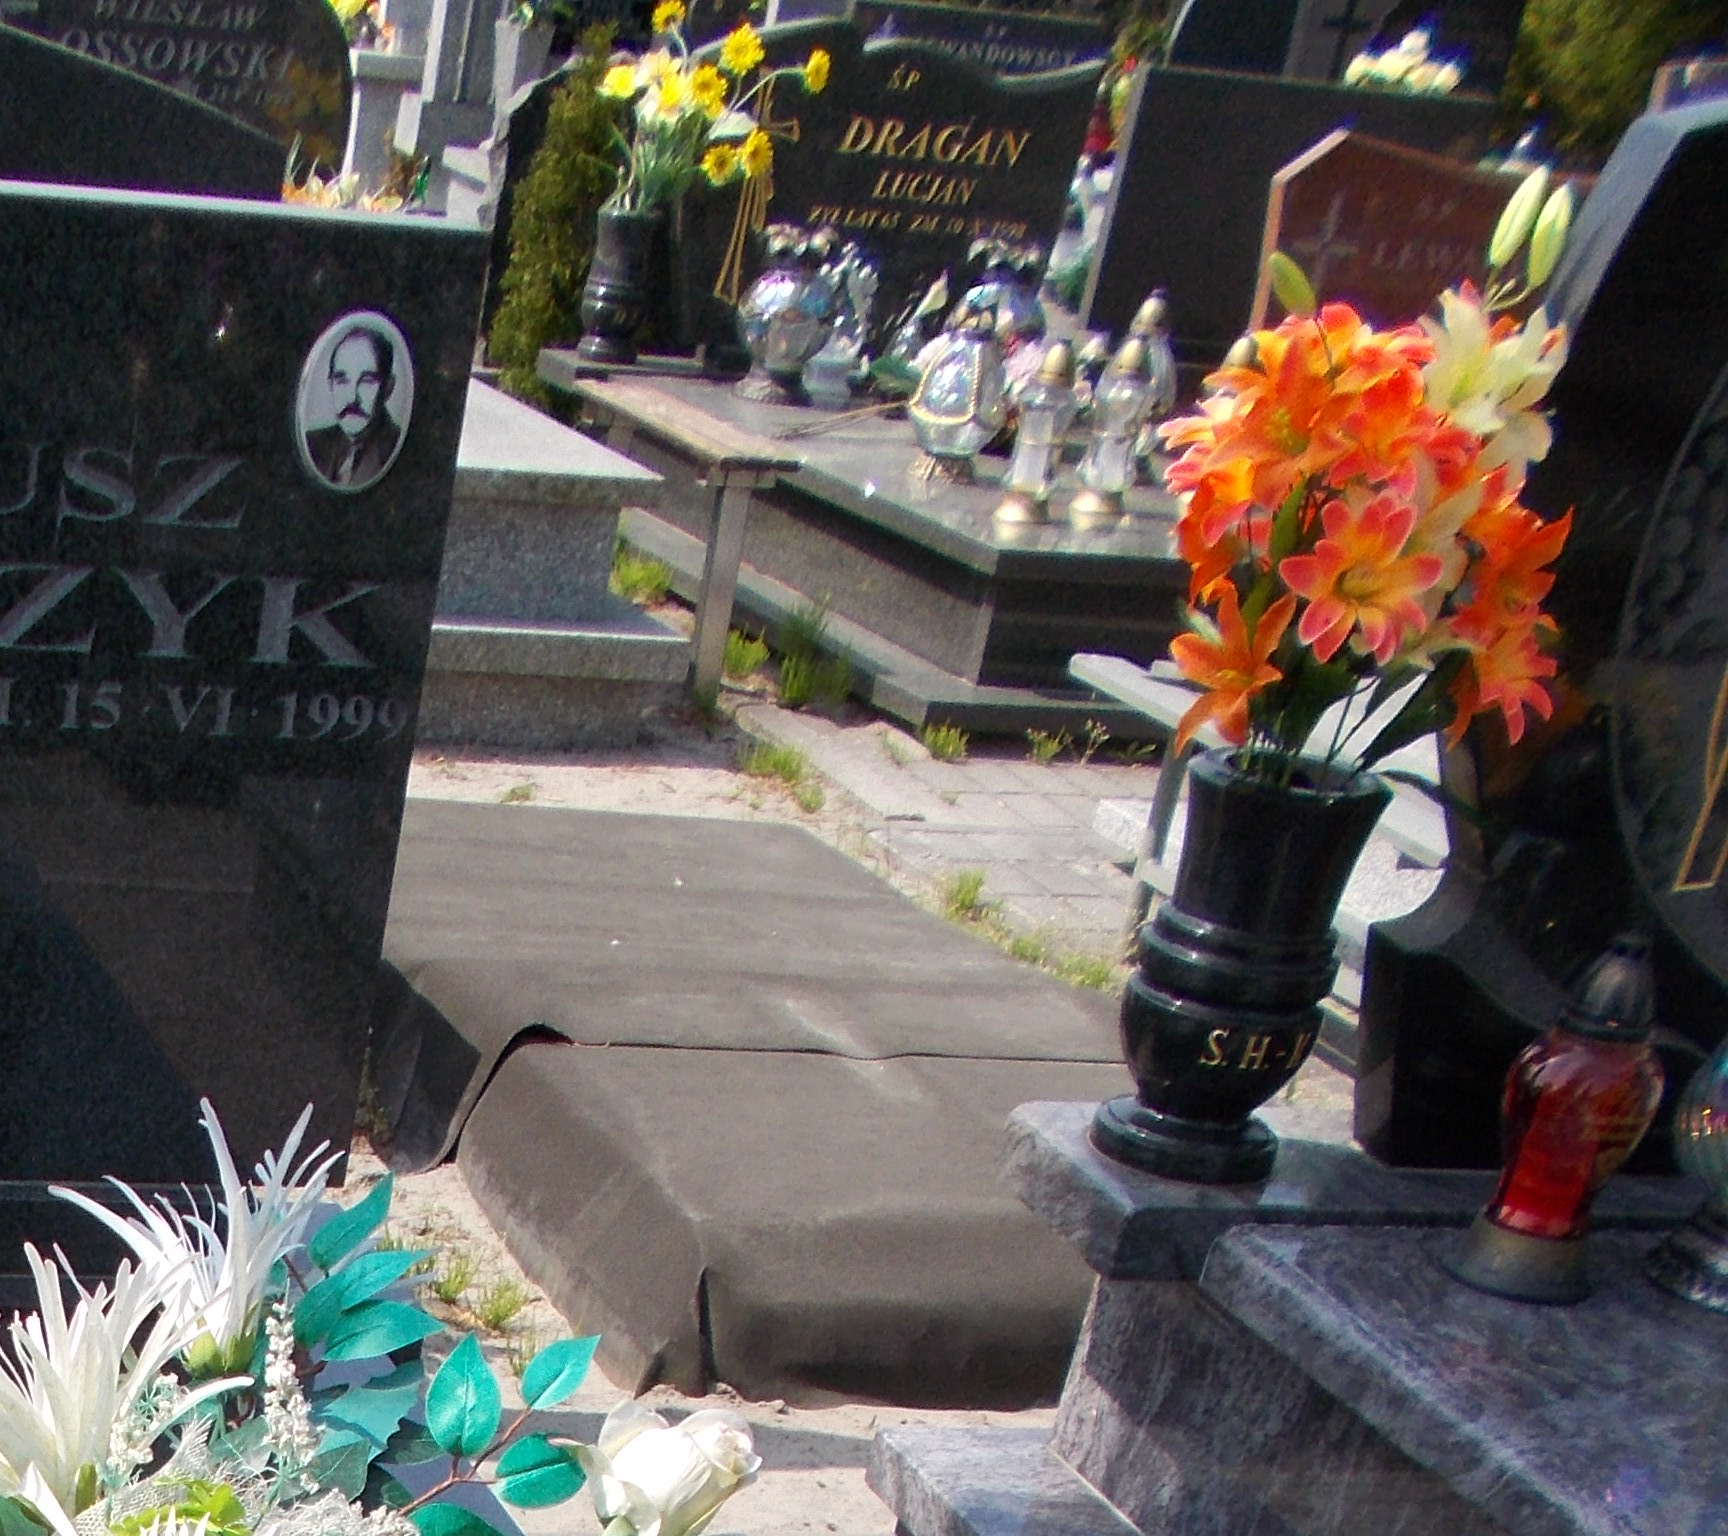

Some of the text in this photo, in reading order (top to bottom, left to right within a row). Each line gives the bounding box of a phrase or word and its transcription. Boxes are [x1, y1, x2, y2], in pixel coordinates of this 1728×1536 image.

[837, 115, 1031, 168] DRAGAN
[60, 681, 122, 731] 15
[161, 685, 238, 737] VI
[275, 691, 409, 742] 1999
